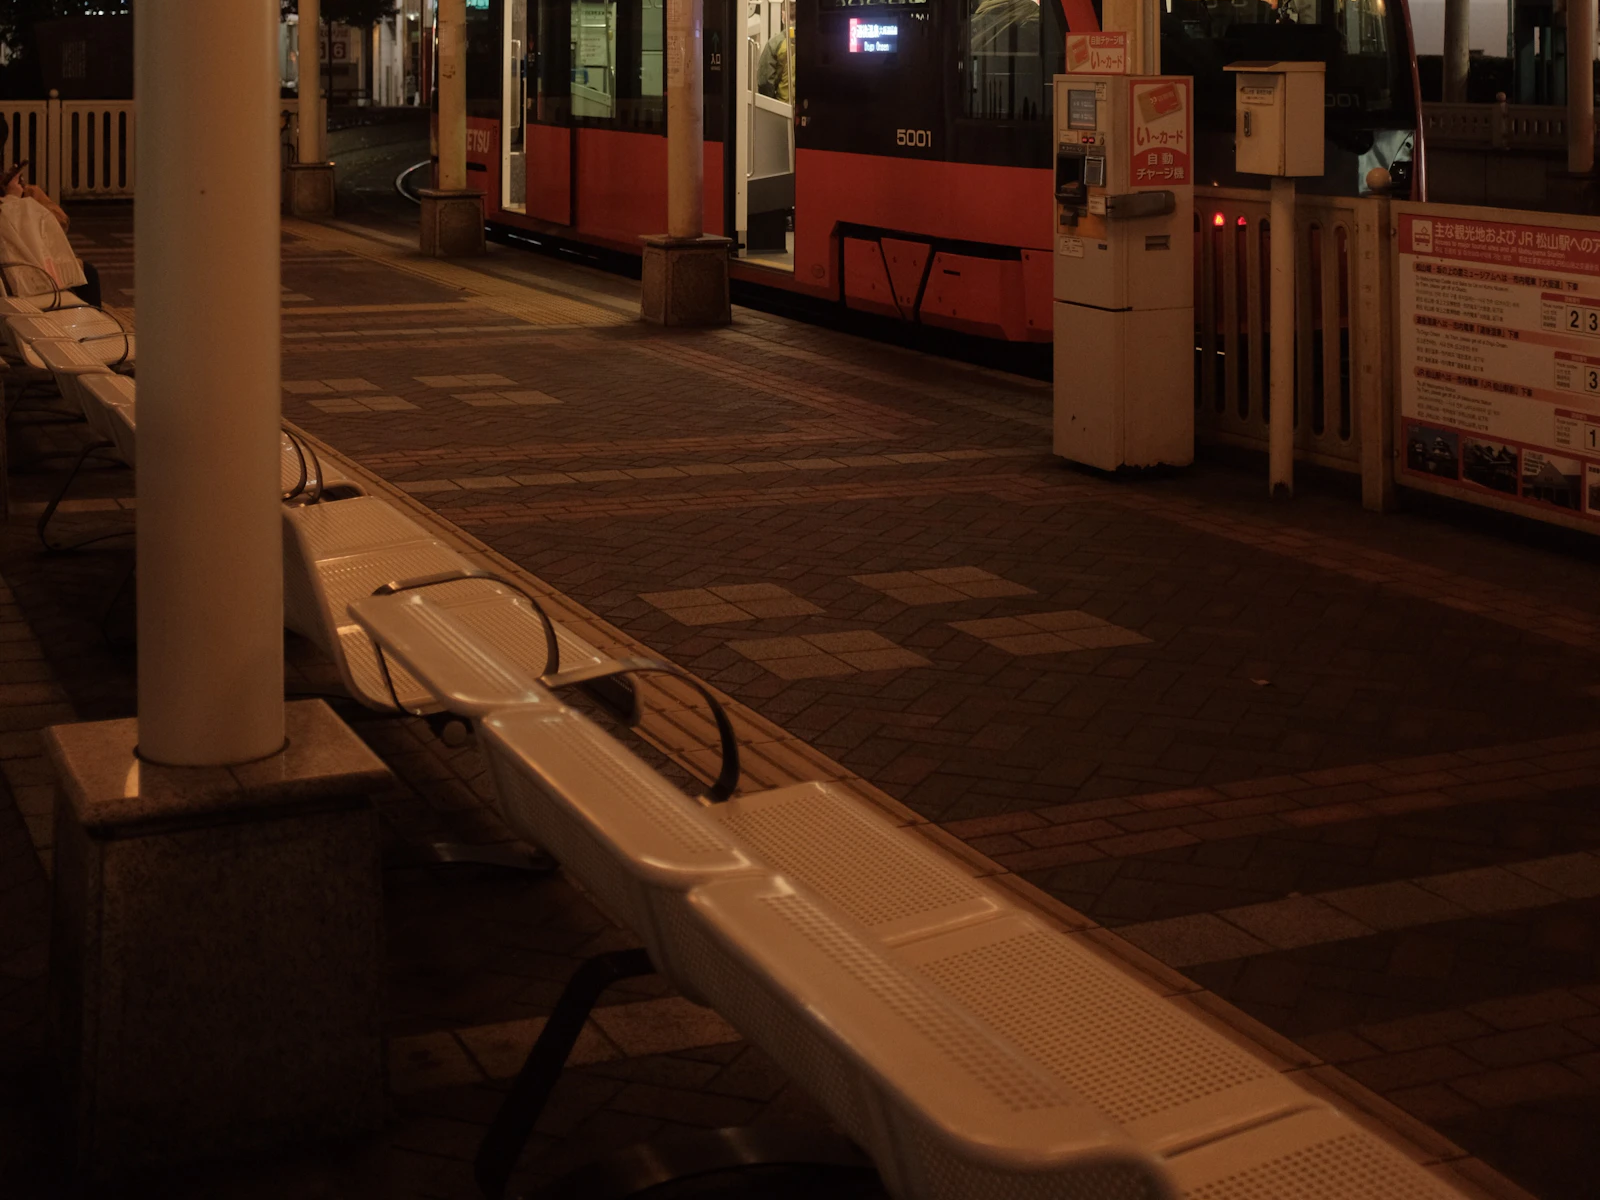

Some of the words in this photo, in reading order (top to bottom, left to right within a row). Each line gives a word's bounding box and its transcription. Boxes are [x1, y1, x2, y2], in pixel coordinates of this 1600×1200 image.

[466, 129, 490, 153] ETSU
[896, 128, 932, 148] 5001
[1136, 168, 1184, 181] チャージ機
[1518, 231, 1533, 247] JR
[1570, 310, 1579, 328] 2
[1589, 312, 1598, 331] 3
[1589, 371, 1598, 390] 3
[1589, 429, 1596, 448] 1
